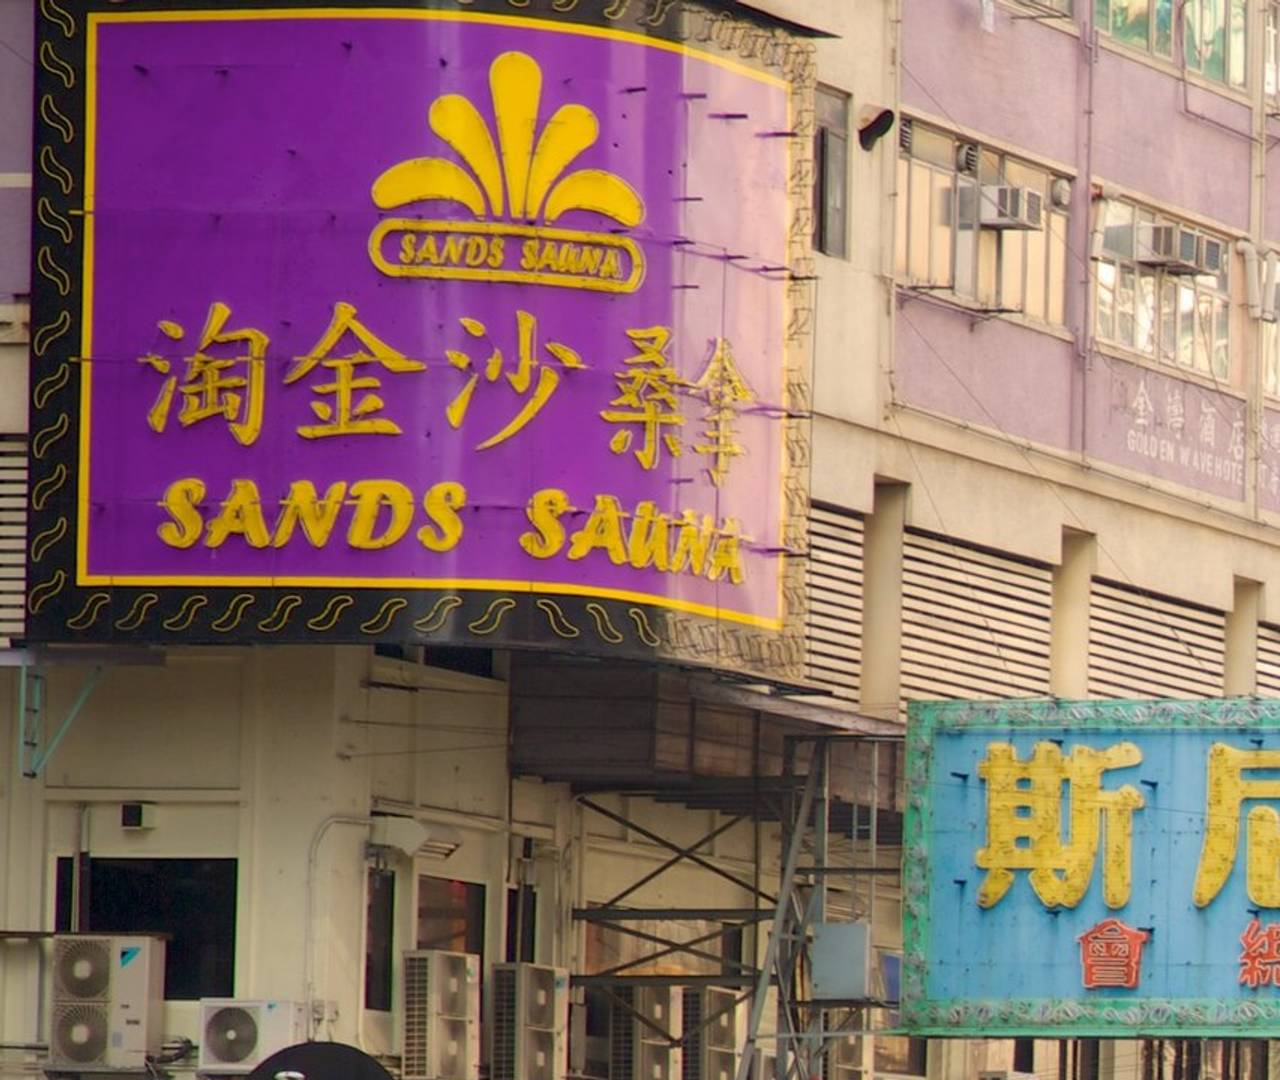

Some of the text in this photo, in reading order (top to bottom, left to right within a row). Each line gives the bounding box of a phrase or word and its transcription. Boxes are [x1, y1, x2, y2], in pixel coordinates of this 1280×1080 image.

[398, 232, 624, 281] SANDS SAUNA
[146, 302, 757, 487] 淘金沙桑拿
[157, 478, 745, 584] SANDS SAUNA
